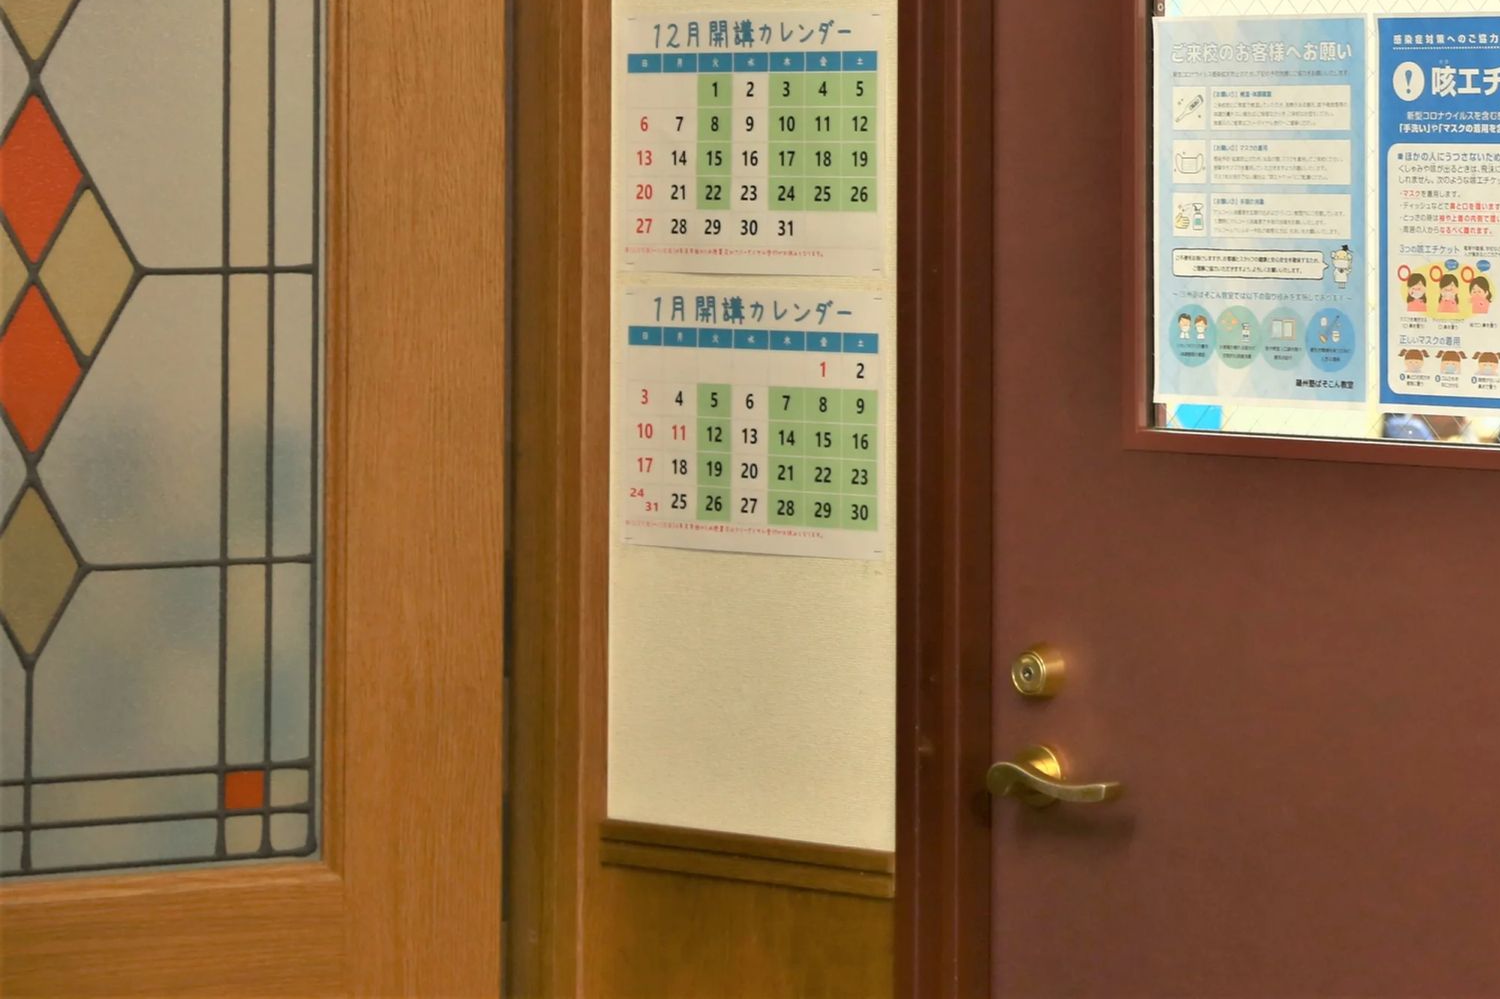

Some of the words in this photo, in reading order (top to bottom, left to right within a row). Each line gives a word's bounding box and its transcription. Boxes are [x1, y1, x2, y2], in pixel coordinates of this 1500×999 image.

[653, 19, 852, 49] 12月開講カレンダー
[1170, 41, 1352, 63] ご来校のお客様へお願い
[712, 82, 717, 97] 1
[747, 82, 754, 97] 2
[783, 81, 790, 97] 3
[819, 81, 827, 96] 4
[856, 81, 863, 96] 5
[640, 116, 648, 131] 6
[676, 116, 683, 131] 7
[711, 116, 718, 131] 8
[746, 116, 754, 131] 9
[779, 116, 795, 131] 10
[816, 116, 829, 131] 11
[853, 116, 867, 131] 12
[637, 150, 652, 166] 13
[672, 151, 687, 165] 14
[707, 151, 722, 166] 15
[742, 151, 758, 166] 16
[779, 151, 795, 166] 17
[816, 151, 831, 166] 18
[852, 151, 867, 167] 19
[636, 184, 652, 200] 20
[671, 185, 685, 200] 21
[706, 185, 721, 200] 22
[741, 185, 757, 201] 23
[778, 186, 795, 201] 24
[815, 186, 830, 201] 25
[851, 186, 868, 202] 26
[636, 218, 652, 233] 27
[672, 219, 687, 234] 28
[705, 219, 721, 235] 29
[741, 220, 757, 235] 30
[778, 220, 793, 236] 31
[654, 295, 852, 324] 1月開講カレンダー
[820, 362, 825, 377] 1
[857, 363, 864, 378] 2
[641, 389, 648, 404] 3
[675, 391, 683, 406] 4
[711, 392, 718, 408] 5
[746, 394, 754, 409] 6
[782, 395, 790, 410] 7
[819, 397, 827, 412] 8
[857, 398, 864, 414] 9
[638, 423, 653, 439] 10
[672, 425, 685, 440] 11
[707, 427, 722, 442] 12
[742, 428, 757, 444] 13
[779, 430, 795, 445] 14
[816, 432, 831, 448] 15
[853, 433, 868, 449] 16
[638, 457, 653, 472] 17
[672, 459, 687, 475] 18
[707, 461, 722, 477] 19
[741, 463, 758, 479] 20
[778, 465, 793, 480] 21
[815, 467, 831, 483] 22
[851, 469, 868, 485] 23
[630, 488, 644, 498] 24
[672, 493, 686, 509] 25
[706, 496, 722, 511] 26
[741, 498, 757, 513] 27
[777, 500, 794, 516] 28
[815, 502, 831, 518] 29
[852, 504, 868, 520] 30
[645, 502, 659, 512] 31
